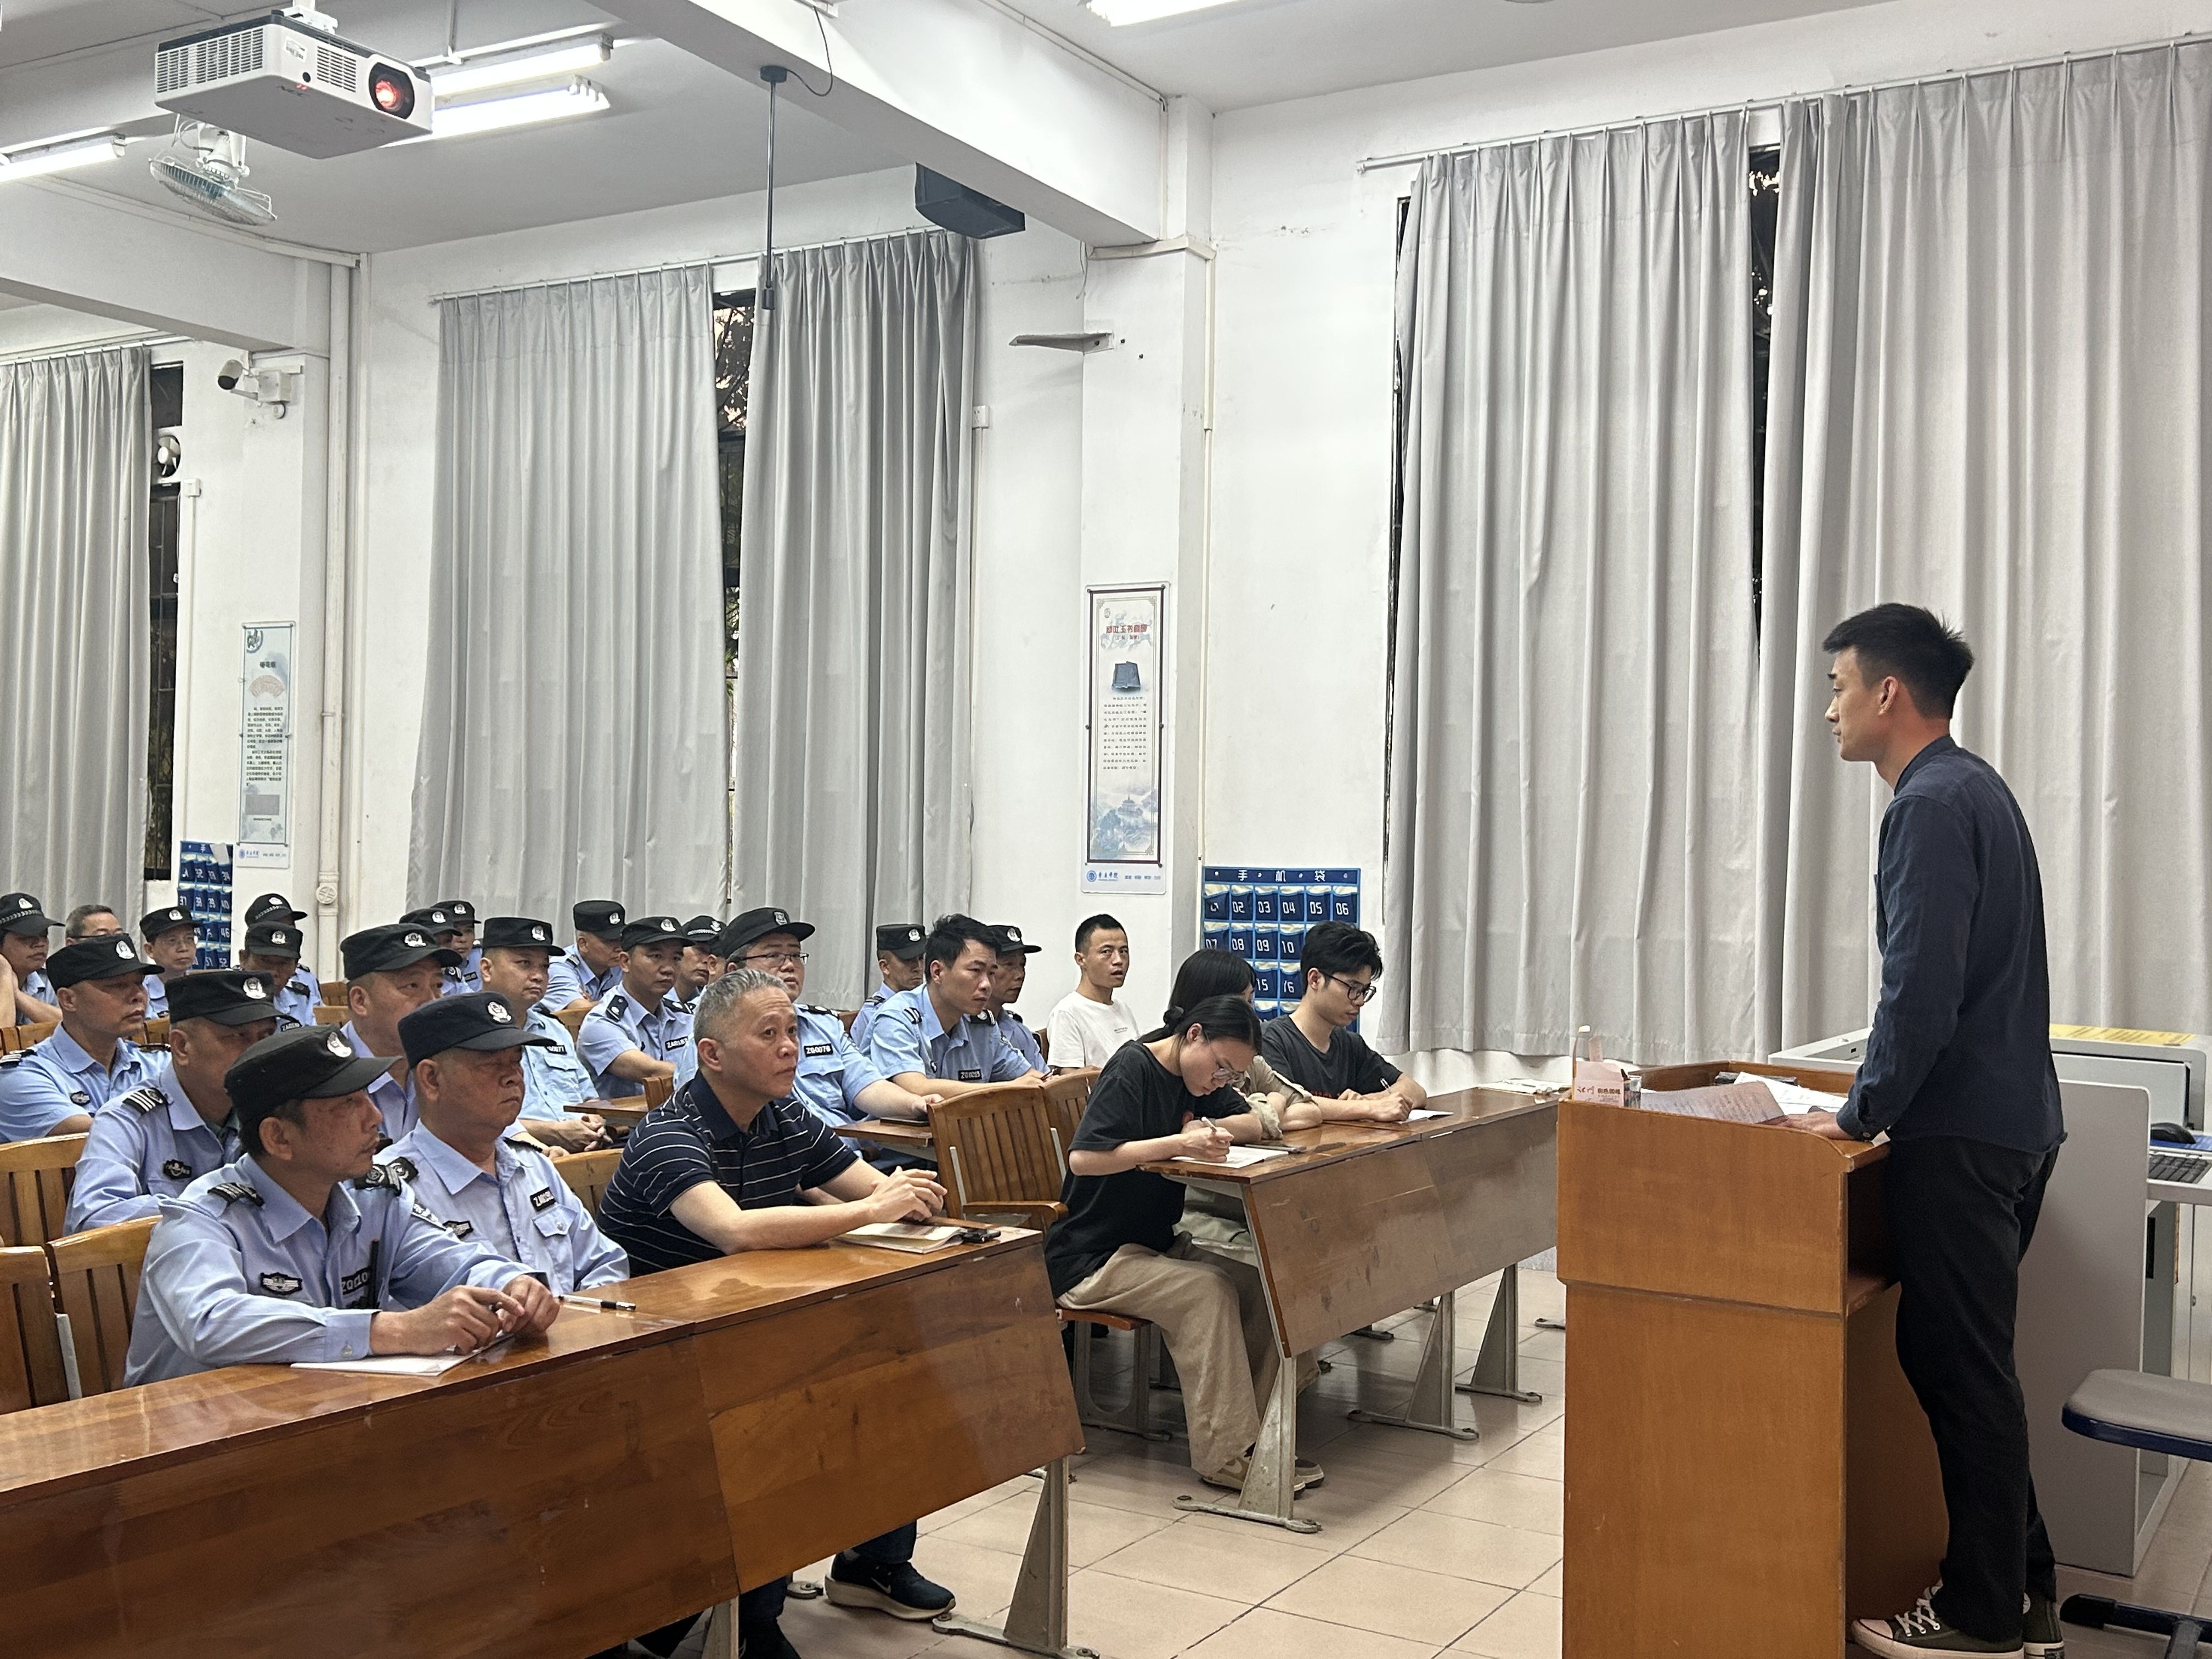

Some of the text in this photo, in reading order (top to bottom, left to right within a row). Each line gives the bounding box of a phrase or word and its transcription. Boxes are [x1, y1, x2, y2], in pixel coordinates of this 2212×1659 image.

[1233, 901, 1245, 913] 02
[1258, 901, 1271, 913] 03
[1283, 902, 1295, 913] 04
[1310, 902, 1322, 914] 05
[1336, 902, 1348, 915] 06
[221, 928, 229, 938] 46
[1232, 939, 1244, 950] 08
[1257, 939, 1269, 951] 09
[1282, 940, 1294, 953] 10
[1256, 979, 1294, 993] 15 16
